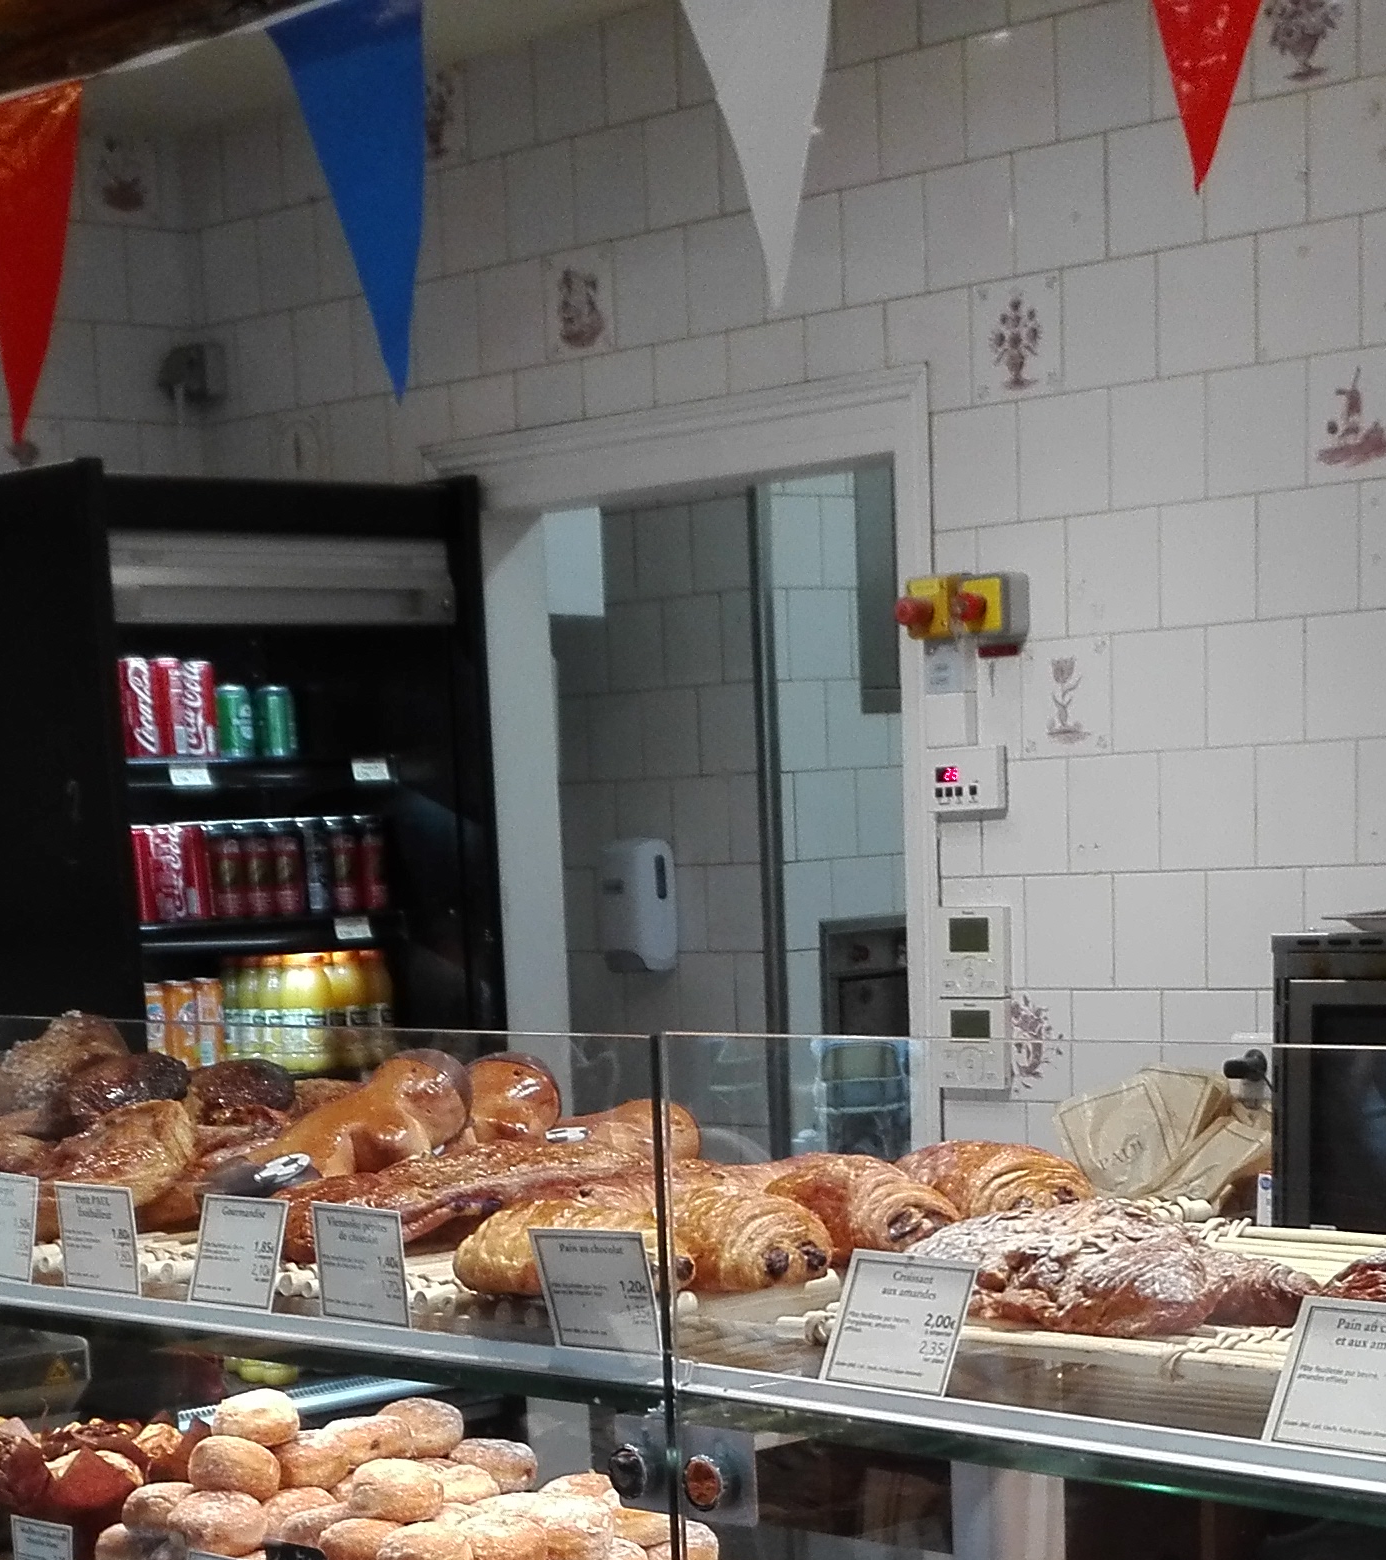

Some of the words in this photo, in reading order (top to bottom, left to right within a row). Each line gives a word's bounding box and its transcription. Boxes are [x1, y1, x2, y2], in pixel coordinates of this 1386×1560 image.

[893, 1269, 935, 1285] Croissant
[881, 1287, 897, 1296] aux
[899, 1287, 938, 1301] amandes
[923, 1312, 956, 1331] 2,00€
[1336, 1317, 1362, 1332] Pain
[1335, 1336, 1347, 1347] et
[1348, 1339, 1367, 1348] aux
